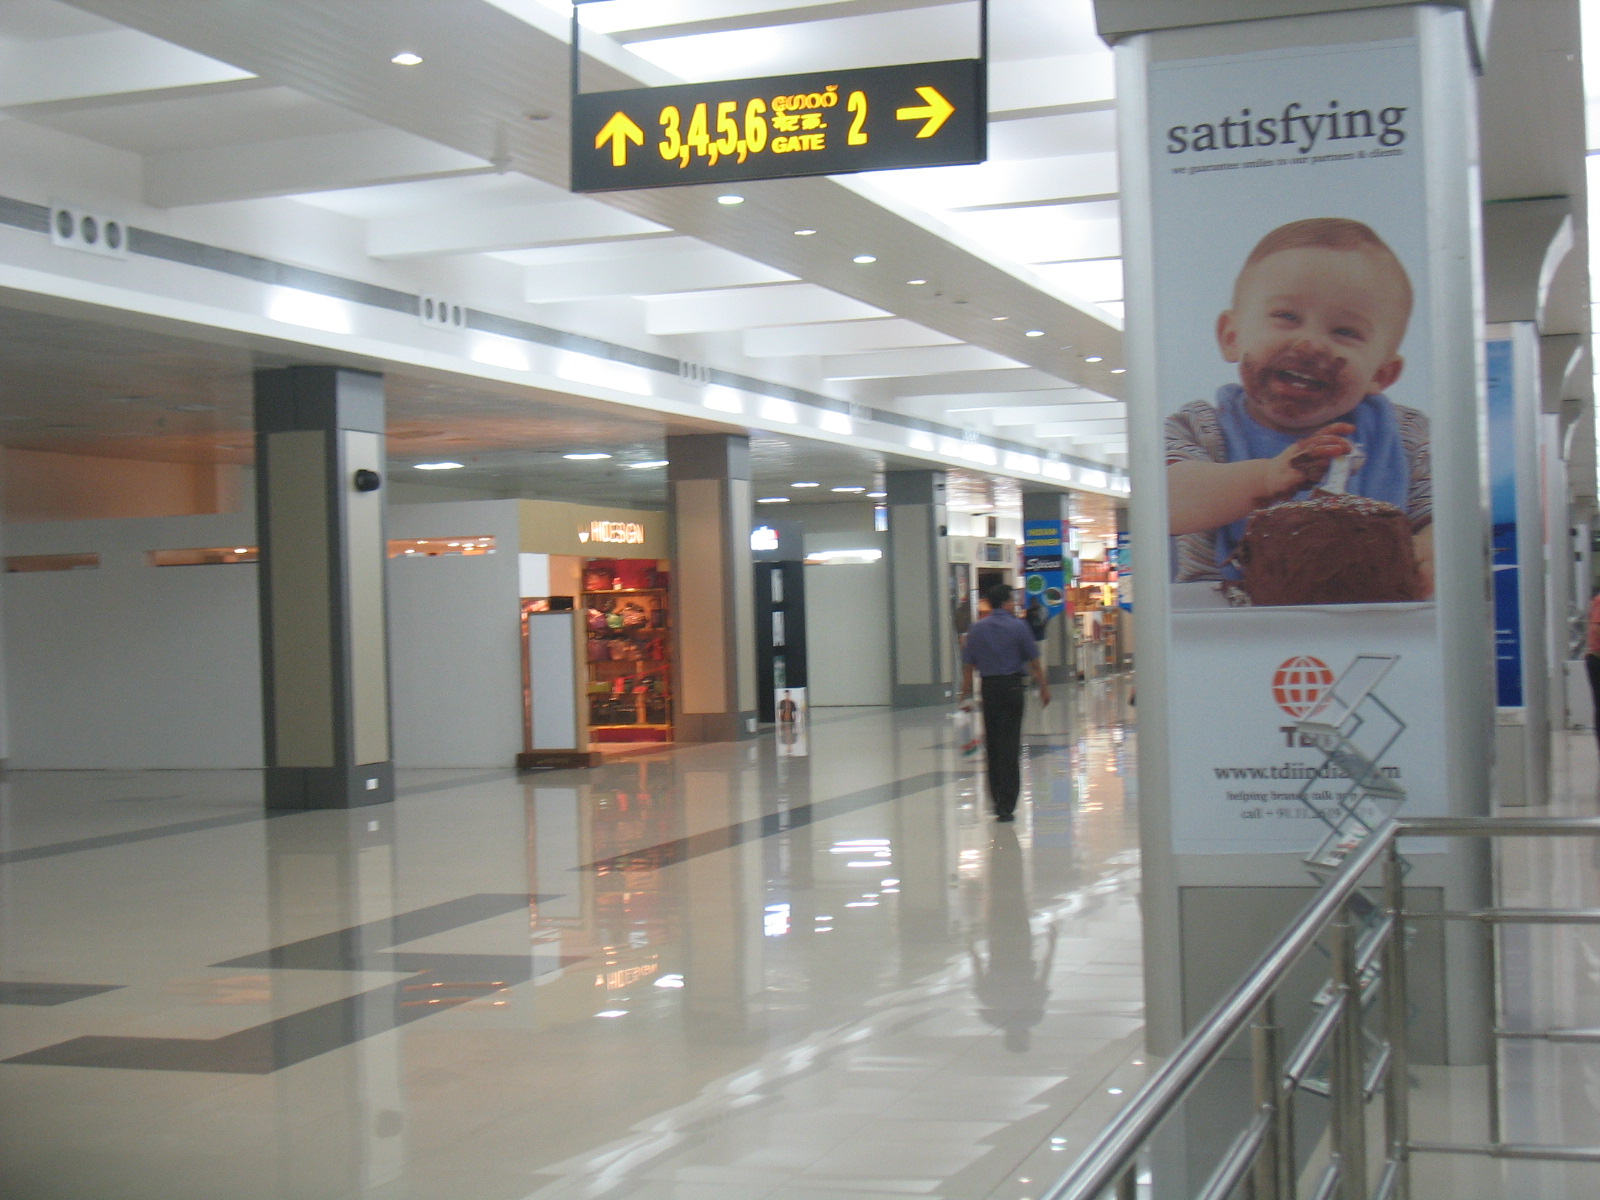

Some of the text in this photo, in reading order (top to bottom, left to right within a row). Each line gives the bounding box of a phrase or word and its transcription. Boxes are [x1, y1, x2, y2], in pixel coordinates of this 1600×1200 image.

[658, 97, 768, 169] 3,4,5,6
[771, 133, 826, 153] GATE
[847, 90, 868, 145] 2
[1167, 100, 1407, 154] satisfying
[591, 521, 644, 544] HIDESIGN
